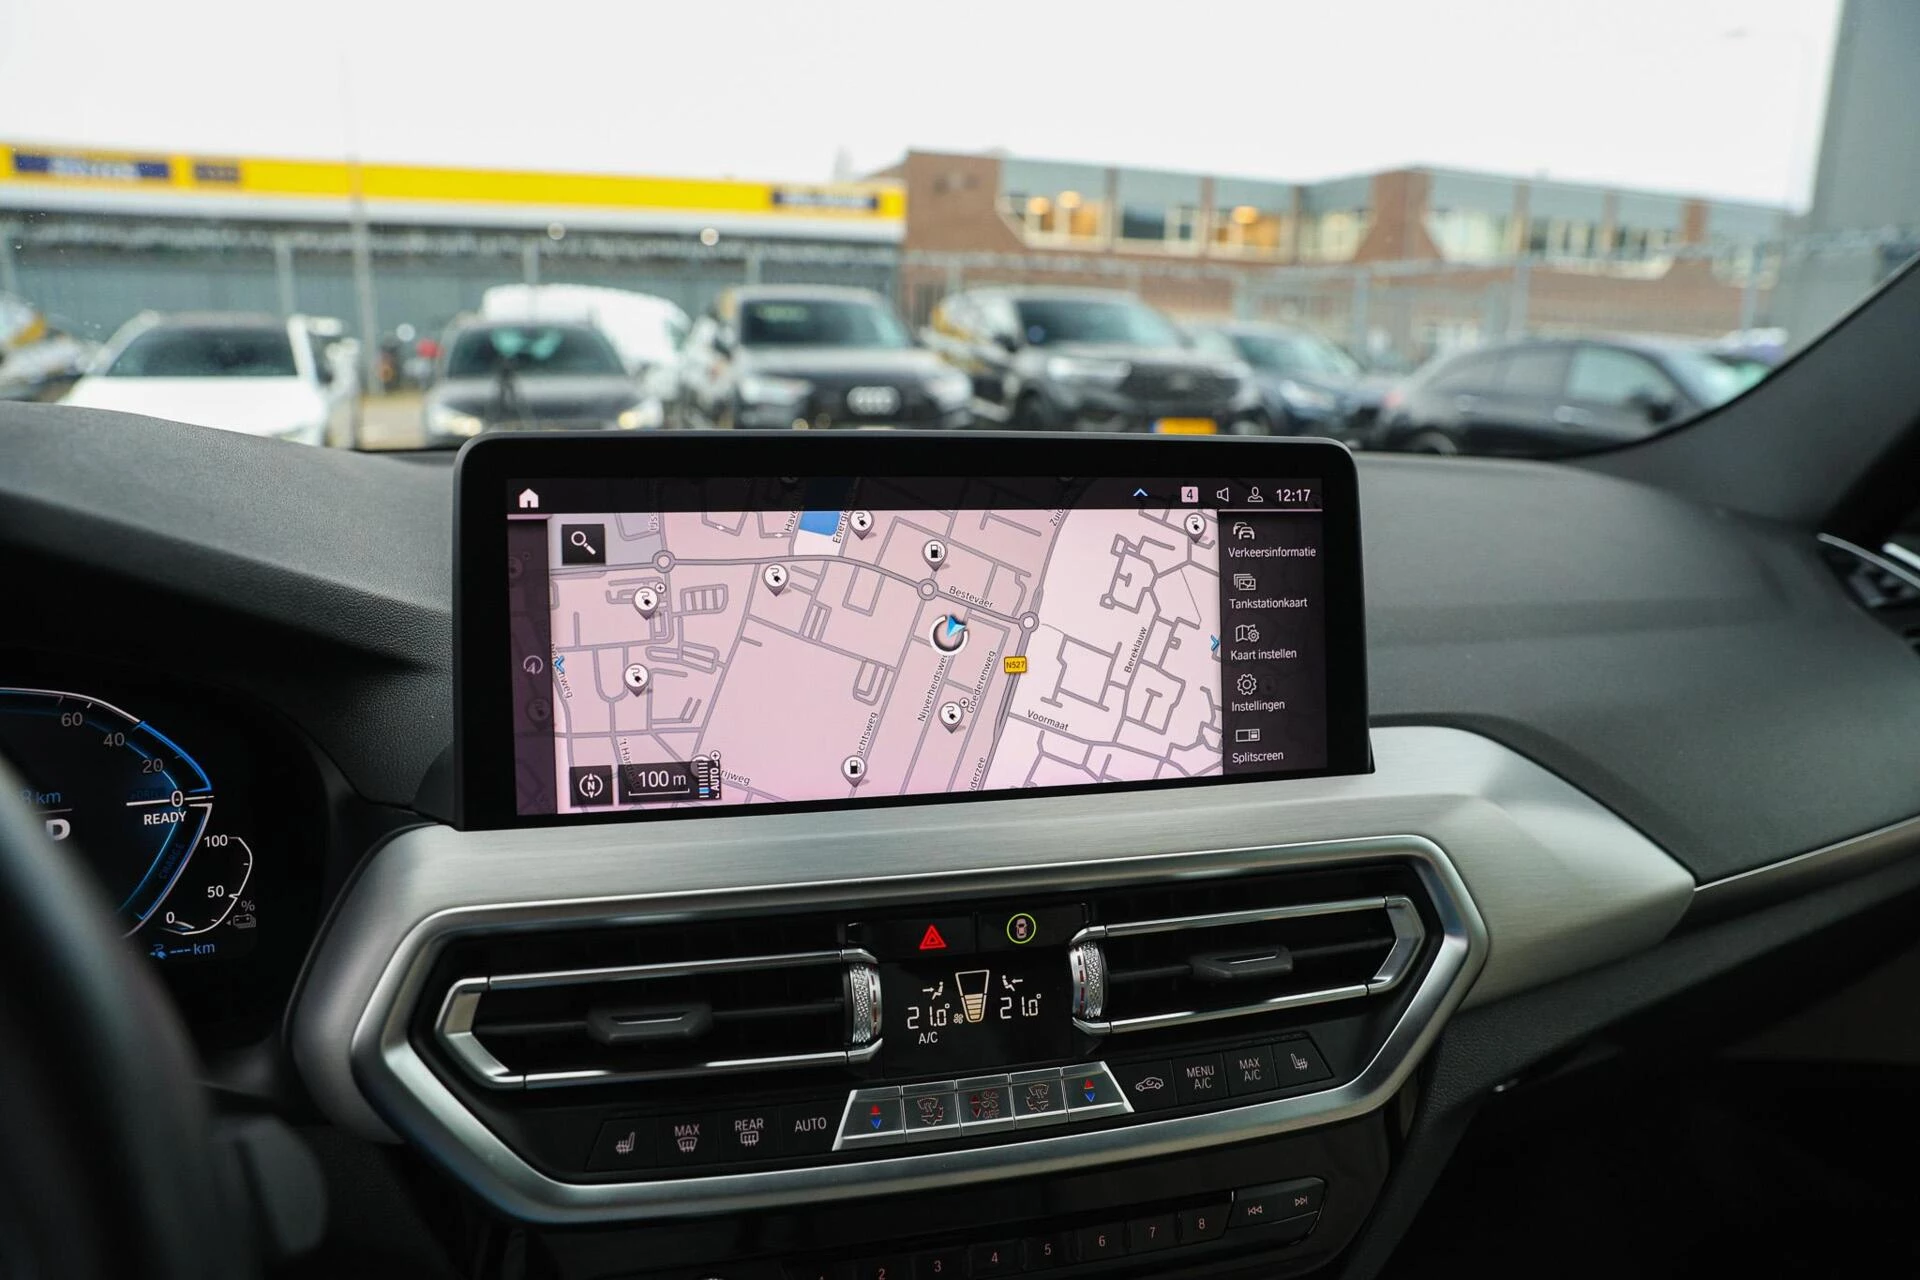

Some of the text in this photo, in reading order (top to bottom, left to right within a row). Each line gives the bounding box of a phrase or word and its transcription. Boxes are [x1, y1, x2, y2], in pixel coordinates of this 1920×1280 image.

[1187, 489, 1194, 501] 4
[1276, 489, 1311, 502] 12:17
[1228, 546, 1317, 558] Verkeersinformatie
[948, 585, 993, 609] Bestevaer
[1230, 597, 1308, 610] Tankstationkaart
[1123, 626, 1148, 674] Bereklauw
[1231, 649, 1297, 661] Kaart instellen
[1006, 661, 1025, 670] N527
[966, 650, 996, 714] Goederenweg
[1231, 700, 1286, 714] Instellingen
[61, 711, 83, 728] 60
[1027, 709, 1069, 732] Voormaat
[103, 732, 126, 748] 40
[1232, 750, 1284, 763] Splitscreen
[142, 758, 164, 774] 20
[638, 770, 669, 788] 100
[673, 773, 687, 787] m
[709, 767, 720, 792] AUTO
[36, 790, 62, 805] km
[170, 790, 184, 808] 0
[143, 811, 187, 826] READY
[204, 834, 228, 849] 100
[207, 885, 225, 899] 50
[166, 911, 175, 924] 0
[193, 943, 215, 955] km
[918, 1031, 938, 1045] A/C
[1239, 1057, 1260, 1070] MAX
[1186, 1065, 1215, 1078] MENU
[1244, 1069, 1261, 1081] A/C
[1194, 1077, 1212, 1090] A/C
[674, 1124, 700, 1137] MAX
[734, 1118, 764, 1132] REAR
[795, 1117, 827, 1132] AUTO
[1198, 1218, 1205, 1230] 8
[1149, 1227, 1156, 1239] 7
[1099, 1235, 1106, 1248] 6
[1044, 1243, 1051, 1256] 5
[991, 1252, 999, 1264] 4
[934, 1259, 942, 1273] 3
[878, 1268, 886, 1280] 2
